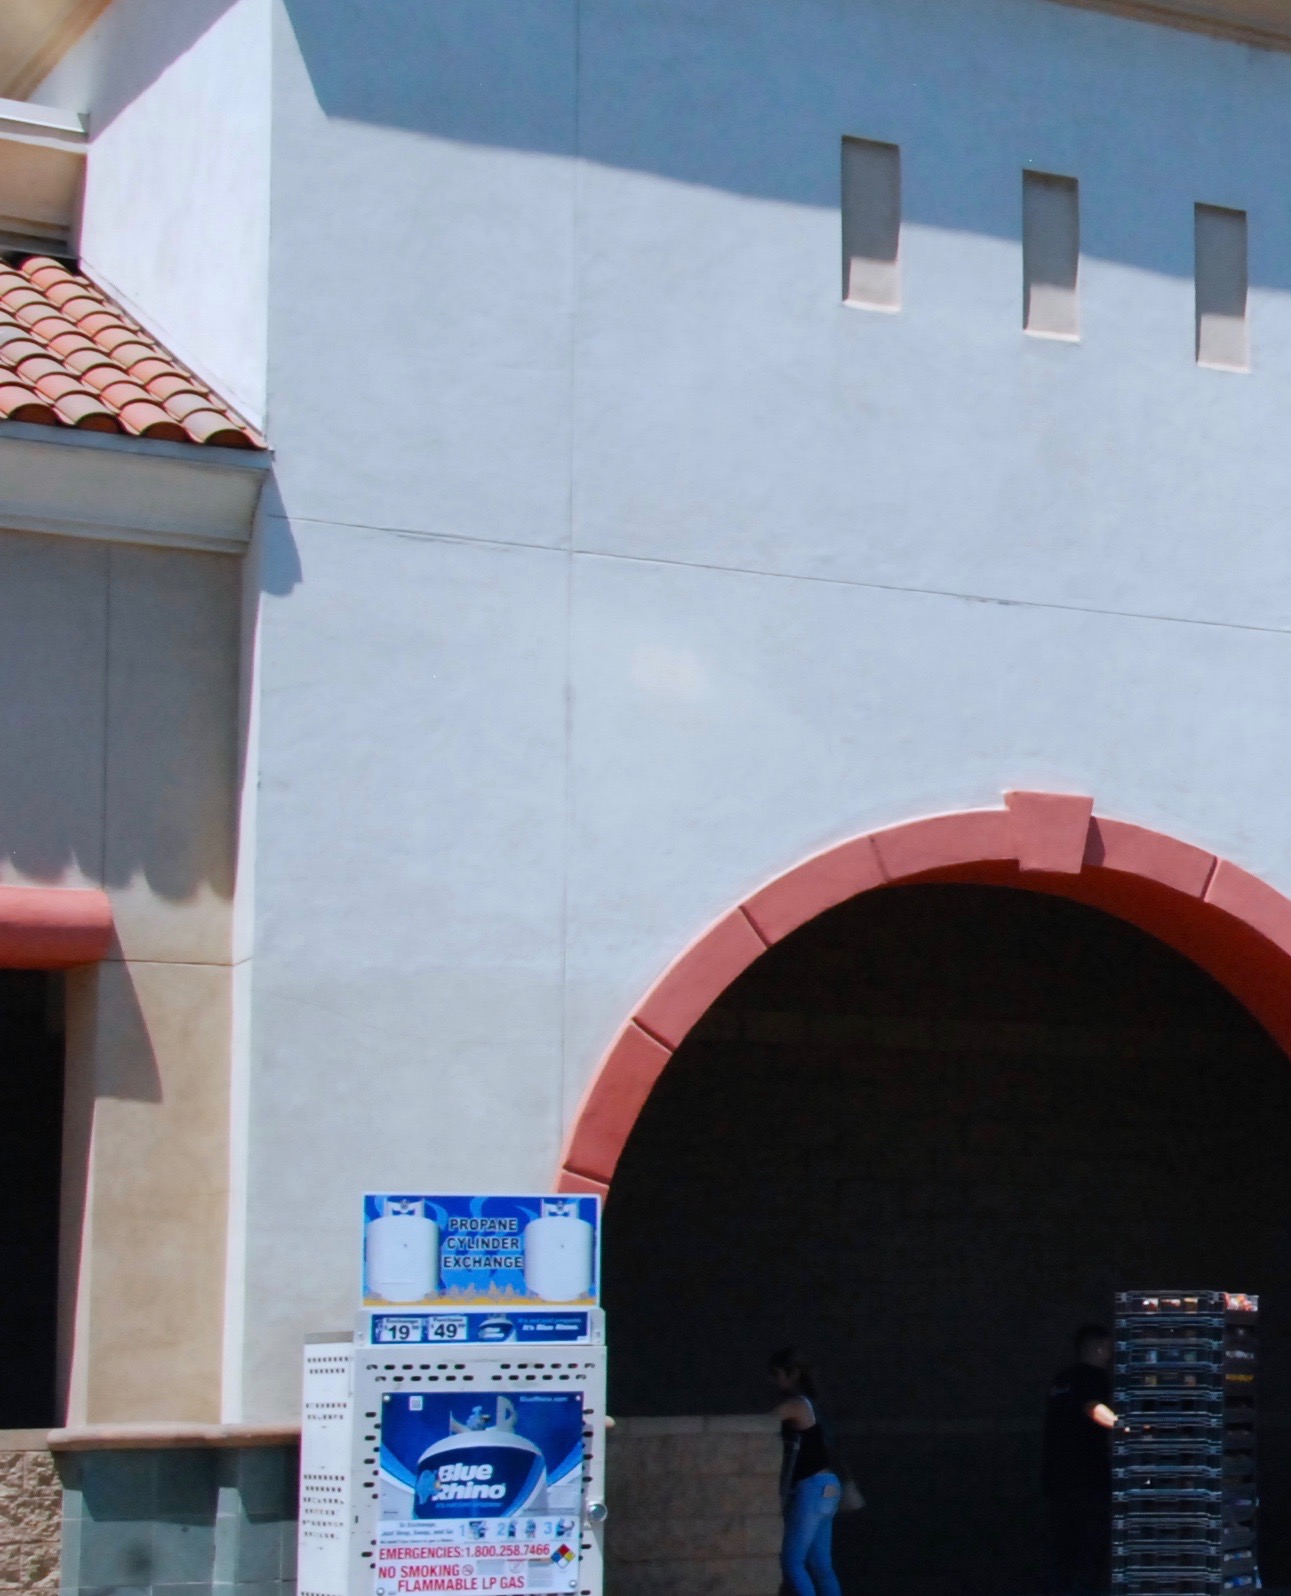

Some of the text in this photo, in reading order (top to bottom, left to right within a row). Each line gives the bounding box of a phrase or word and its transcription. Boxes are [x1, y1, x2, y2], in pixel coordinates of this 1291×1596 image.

[449, 1218, 518, 1232] PROPANE
[446, 1236, 519, 1250] CYLINDER
[443, 1255, 523, 1269] EXCHANGE
[438, 1462, 493, 1482] Blue
[431, 1481, 506, 1502] Rhino
[378, 1564, 460, 1579] NO SMOKING
[398, 1576, 525, 1593] FLAMMABLE LP GAS
